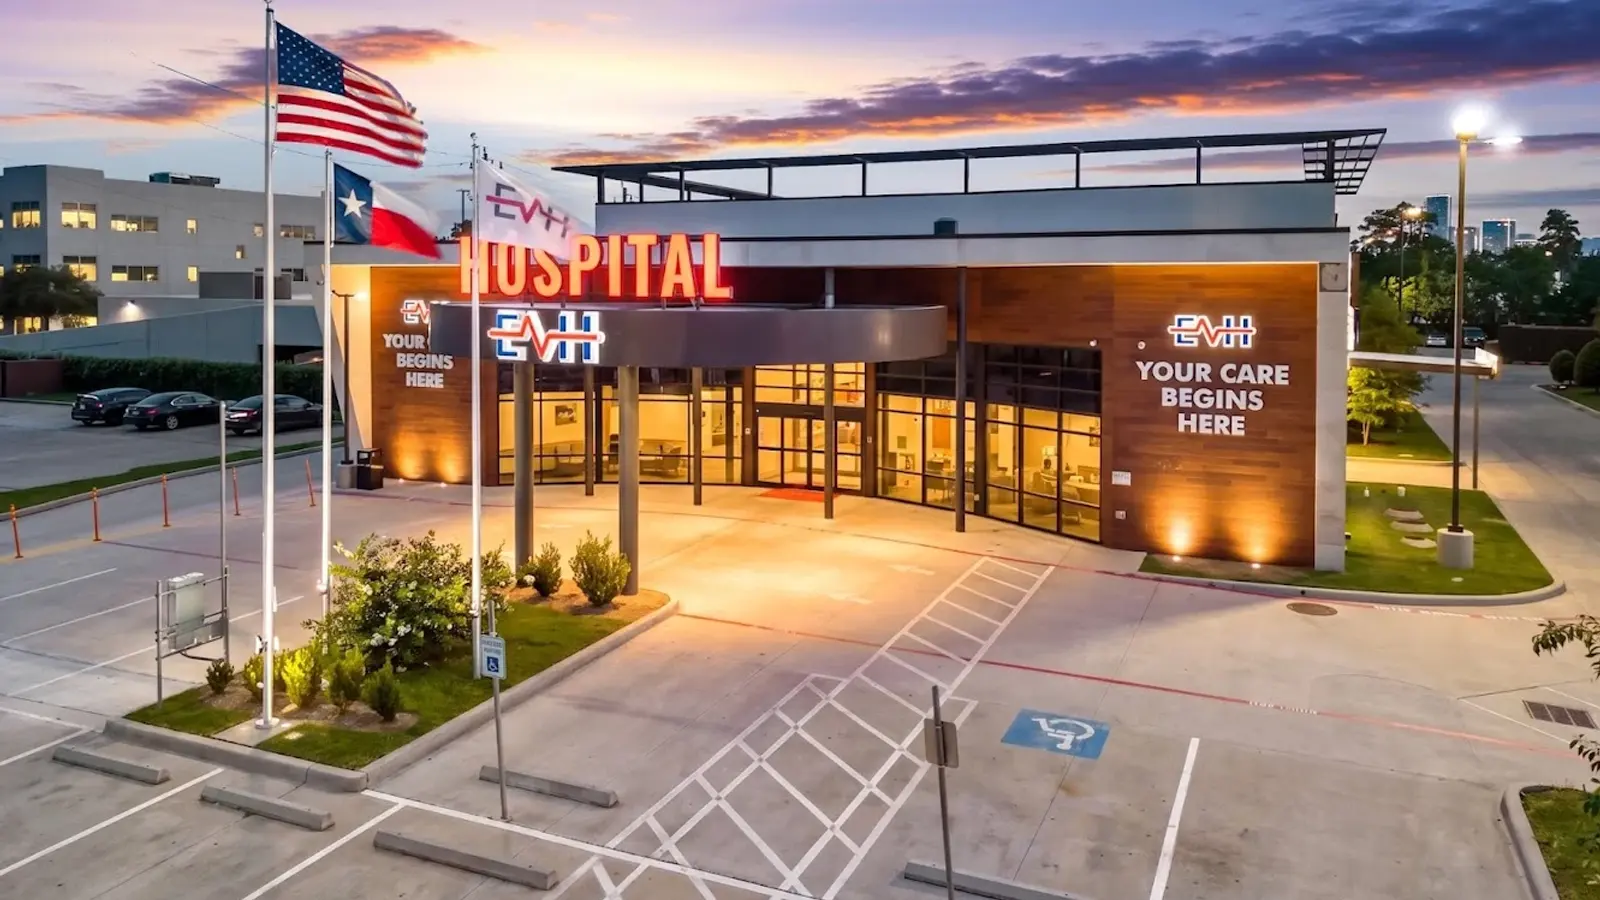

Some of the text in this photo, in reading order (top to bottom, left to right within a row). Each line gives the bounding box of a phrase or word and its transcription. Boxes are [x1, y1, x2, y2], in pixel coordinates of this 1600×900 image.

[459, 232, 734, 299] HOSPITAL
[382, 333, 426, 349] YOUR
[396, 352, 454, 370] BEGINS
[405, 371, 445, 389] HERE
[1135, 361, 1290, 386] YOUR CARE
[1161, 387, 1265, 411] BEGINS
[1177, 412, 1246, 436] HERE
